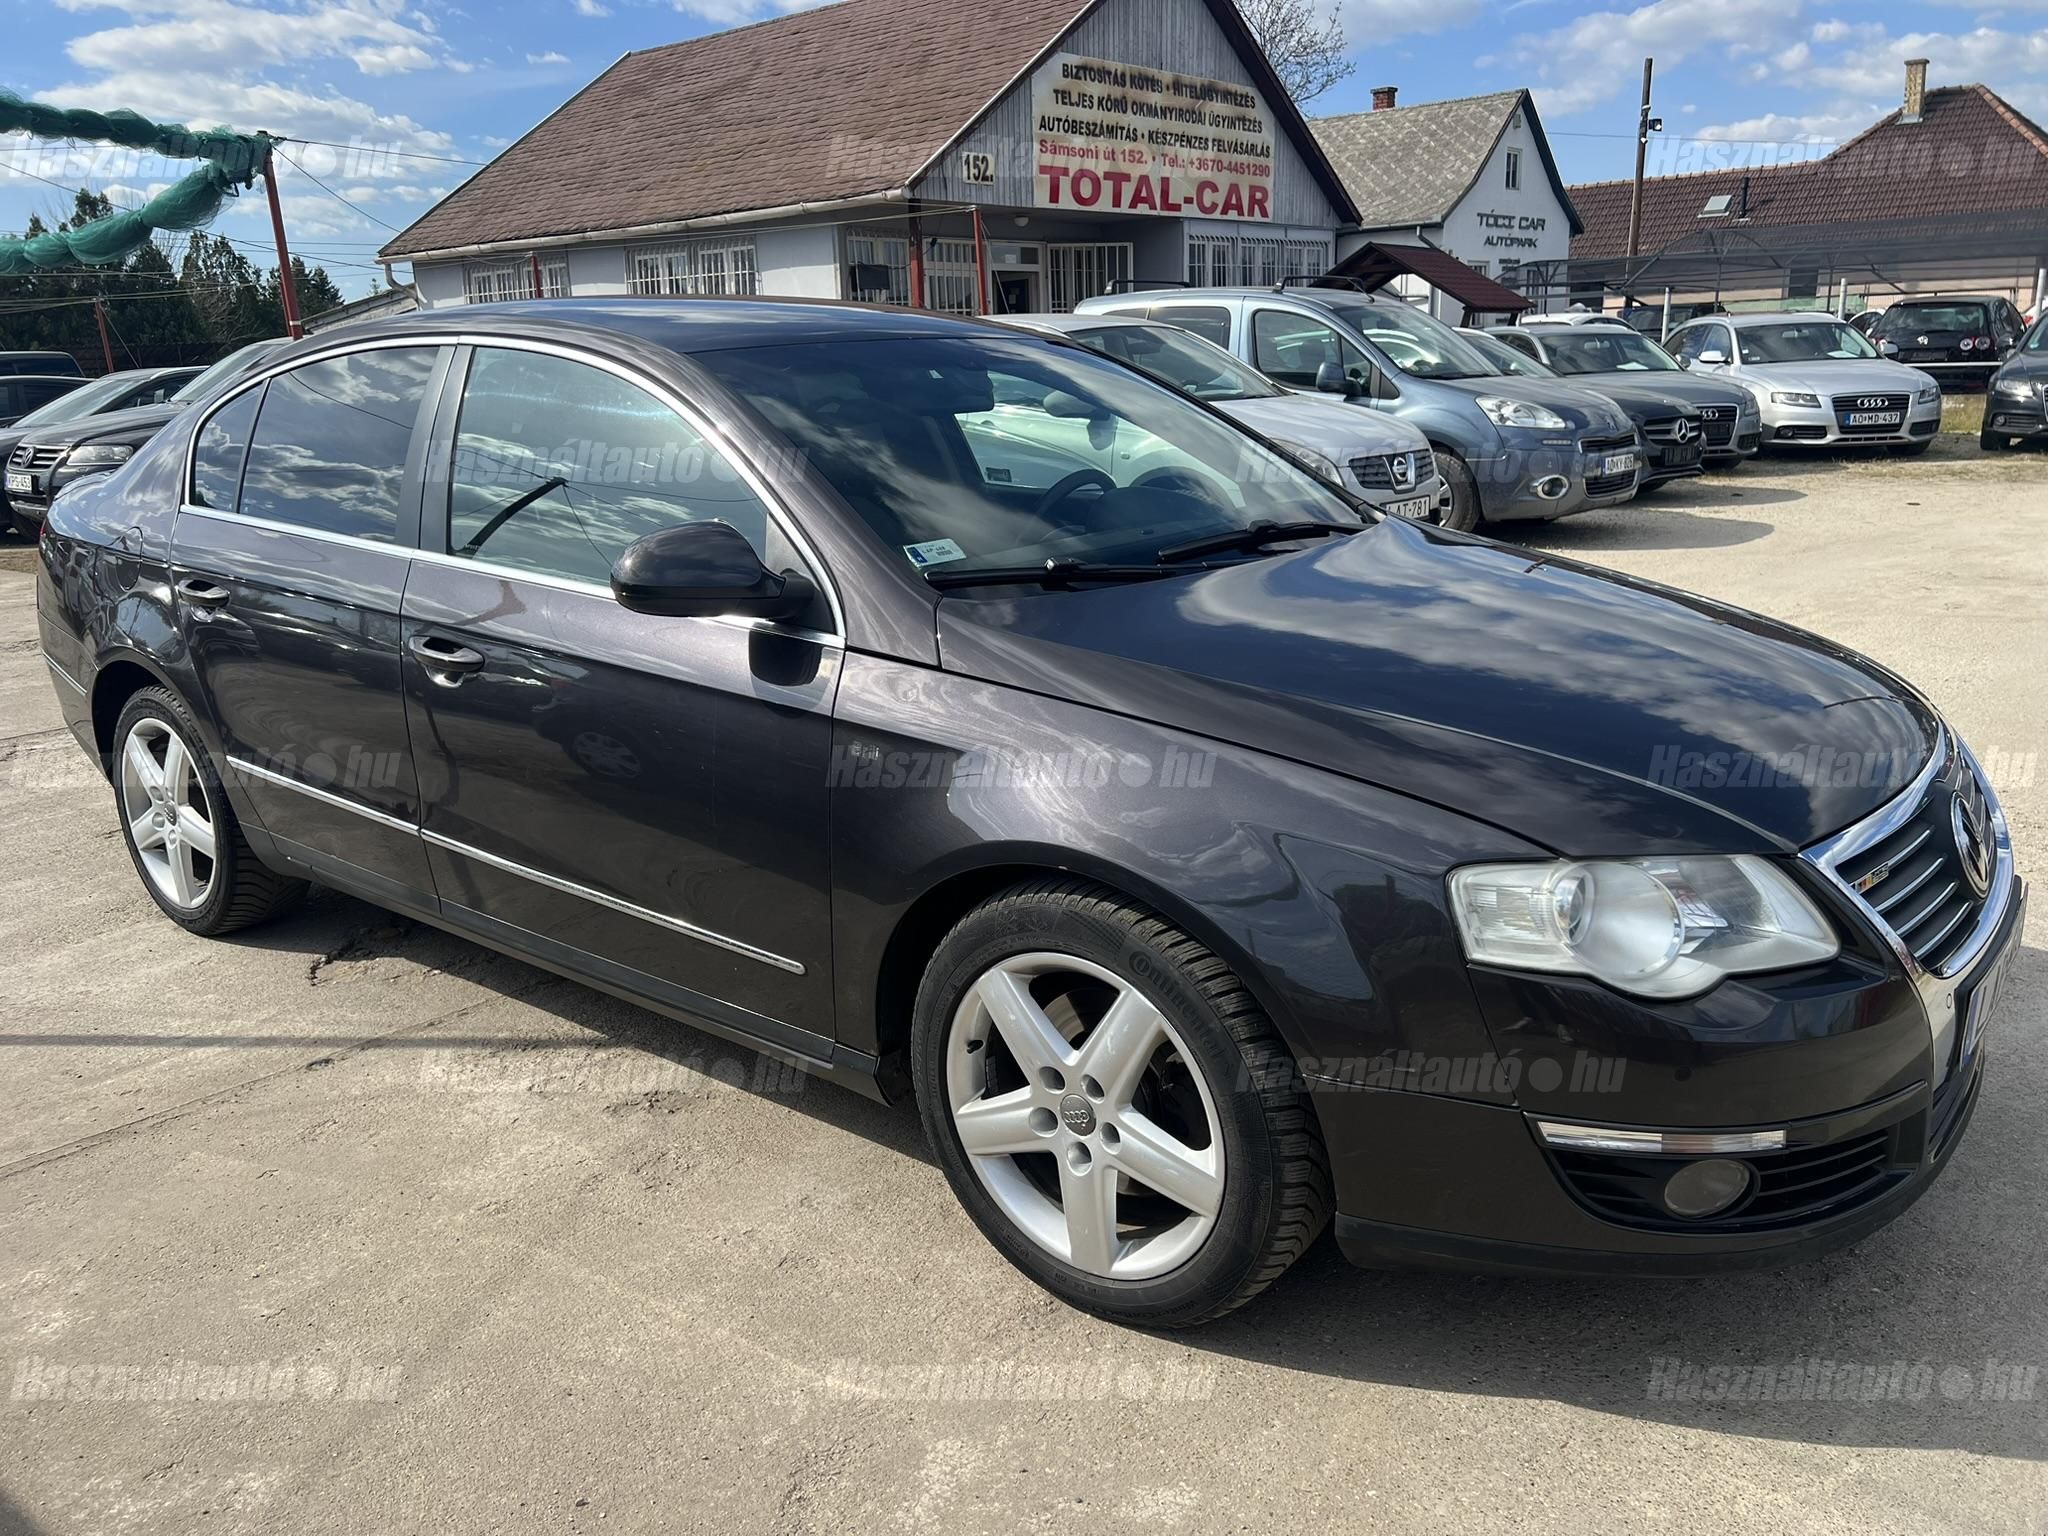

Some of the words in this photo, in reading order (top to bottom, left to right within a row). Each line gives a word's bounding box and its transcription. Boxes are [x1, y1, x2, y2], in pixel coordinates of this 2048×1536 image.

[1062, 63, 1127, 89] BIZTOSÍTÁS
[1053, 89, 1095, 110] TELJES
[1131, 100, 1207, 126] OKMÁNYIRODAI
[1208, 110, 1263, 134] ÜGYINTÉZÉS
[1039, 115, 1138, 143] AUTÓBESZÁMÍTÁS
[1148, 128, 1209, 152] KÉSZPÉNZES
[1211, 138, 1271, 159] FELVÁSÁRLÁS
[964, 154, 993, 182] 152.
[1039, 139, 1099, 160] Sámsoni
[1103, 145, 1116, 162] út
[1120, 148, 1148, 165] 152.
[1161, 153, 1186, 169] Tel.:
[1188, 157, 1271, 178] +3670-4451290
[1039, 165, 1270, 218] TOTAL-CAR
[1518, 216, 1545, 231] CAR
[1483, 233, 1538, 248] AUTÓPARK
